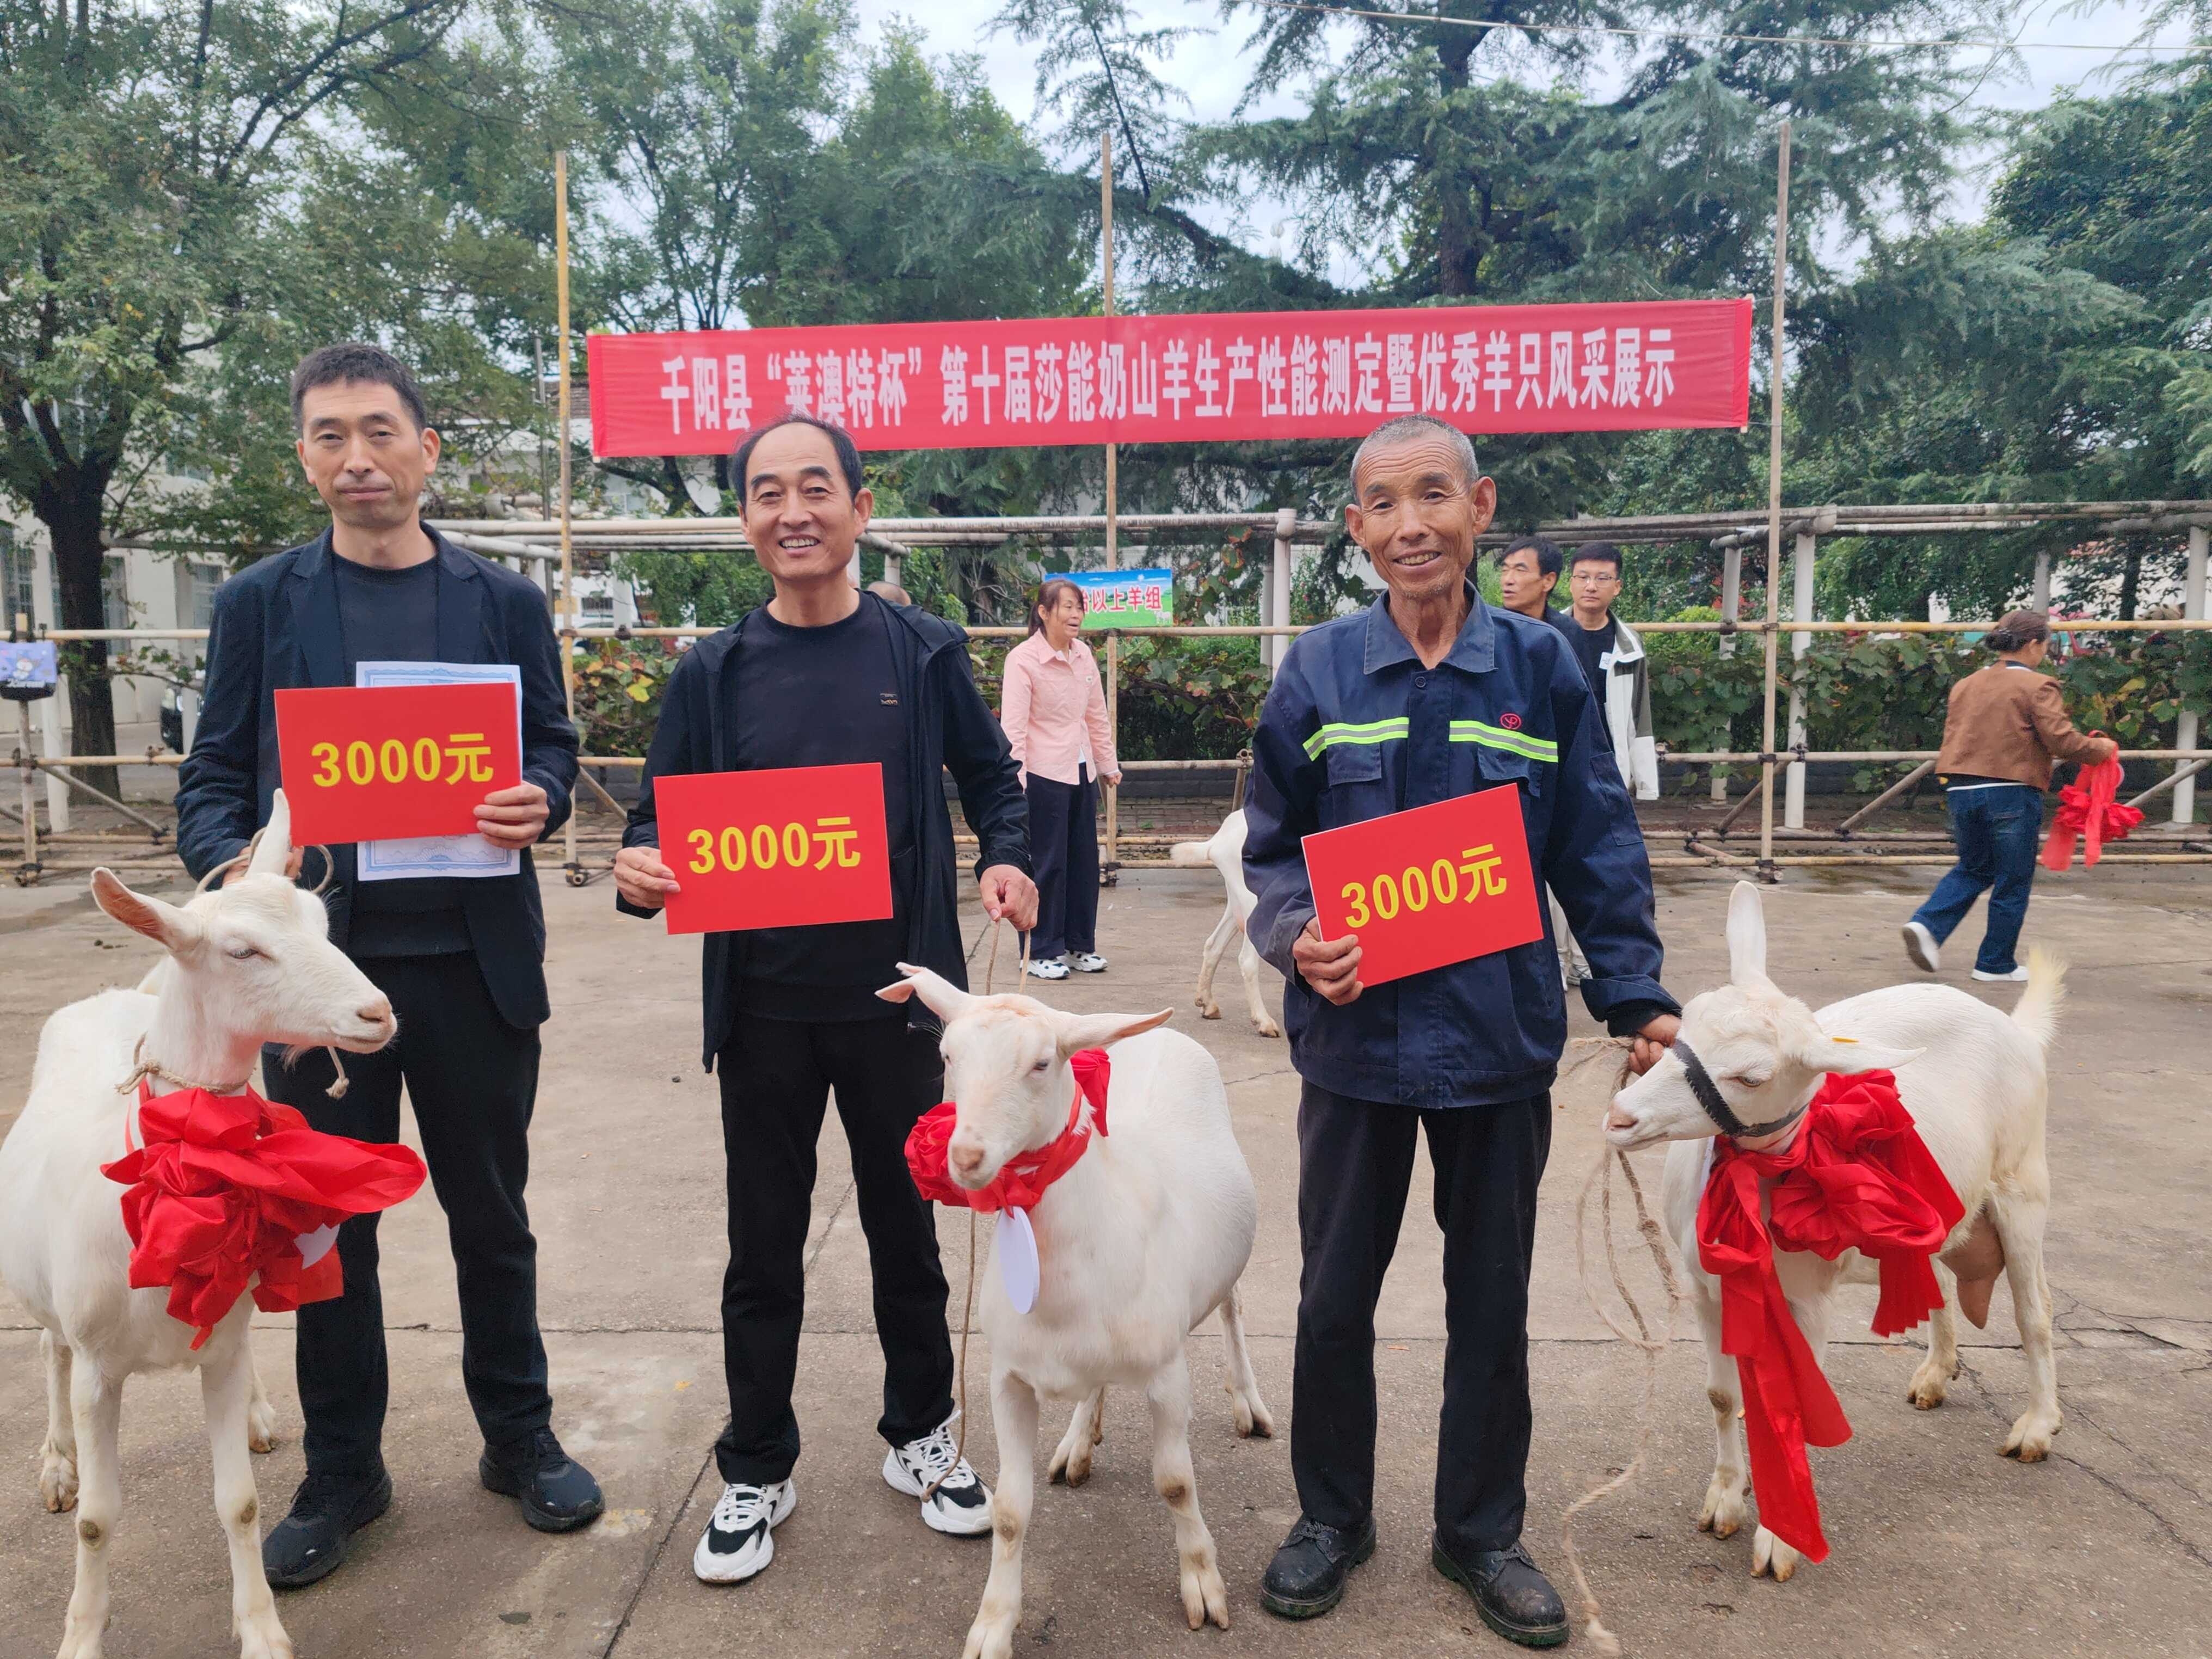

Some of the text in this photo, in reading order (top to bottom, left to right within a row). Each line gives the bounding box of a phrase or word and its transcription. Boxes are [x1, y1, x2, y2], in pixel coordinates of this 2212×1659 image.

[311, 733, 494, 788] 3000元
[687, 817, 861, 874] 3000元
[1341, 843, 1507, 928] 3000元
